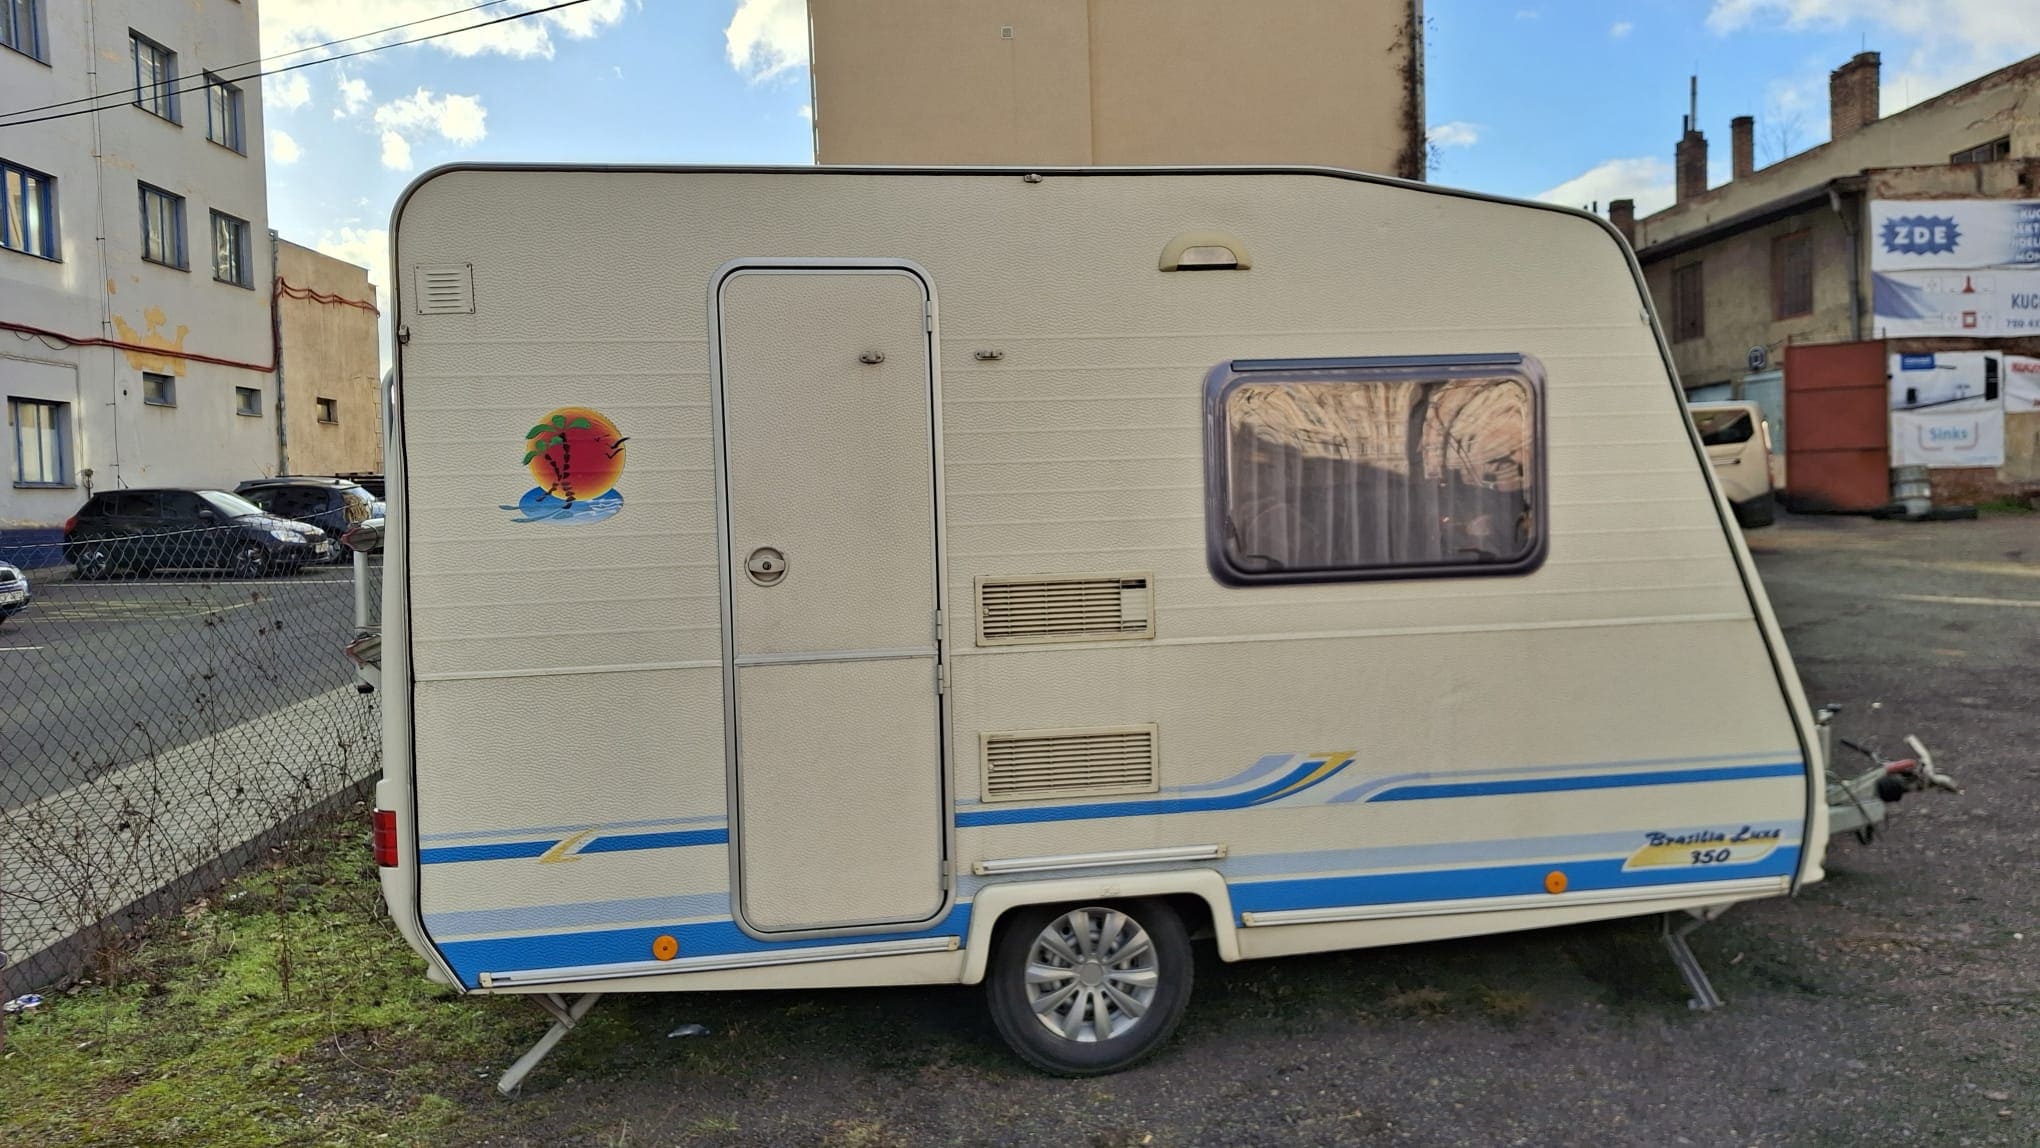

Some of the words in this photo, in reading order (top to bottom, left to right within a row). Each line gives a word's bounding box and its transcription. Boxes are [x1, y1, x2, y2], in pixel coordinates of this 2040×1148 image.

[1893, 226, 1948, 245] ZDE
[2011, 293, 2040, 310] KUC
[1929, 426, 1968, 441] Sinks
[1645, 831, 1725, 847] Brasilia
[1691, 848, 1731, 864] 350
